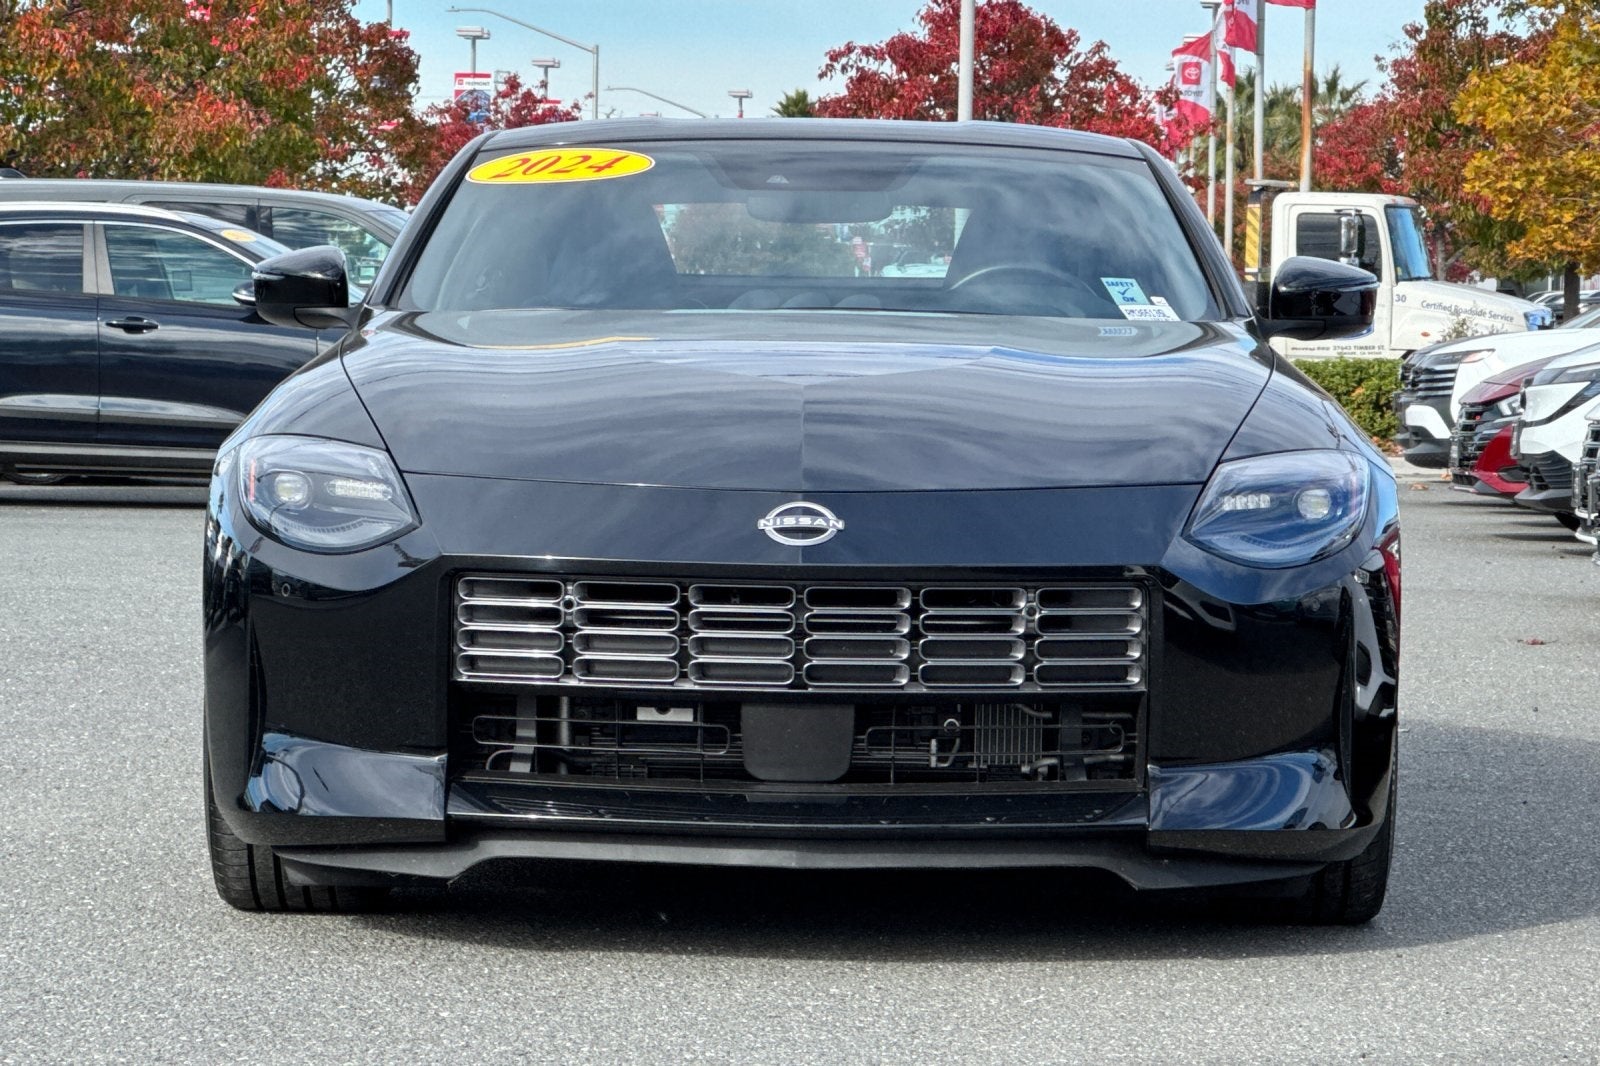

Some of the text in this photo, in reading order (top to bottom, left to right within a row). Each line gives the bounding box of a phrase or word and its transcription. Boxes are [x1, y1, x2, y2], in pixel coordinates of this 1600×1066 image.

[487, 155, 630, 179] 2024
[1394, 293, 1408, 303] 30
[1420, 299, 1515, 322] Certified Roadside Service
[760, 517, 843, 528] NISSAN
